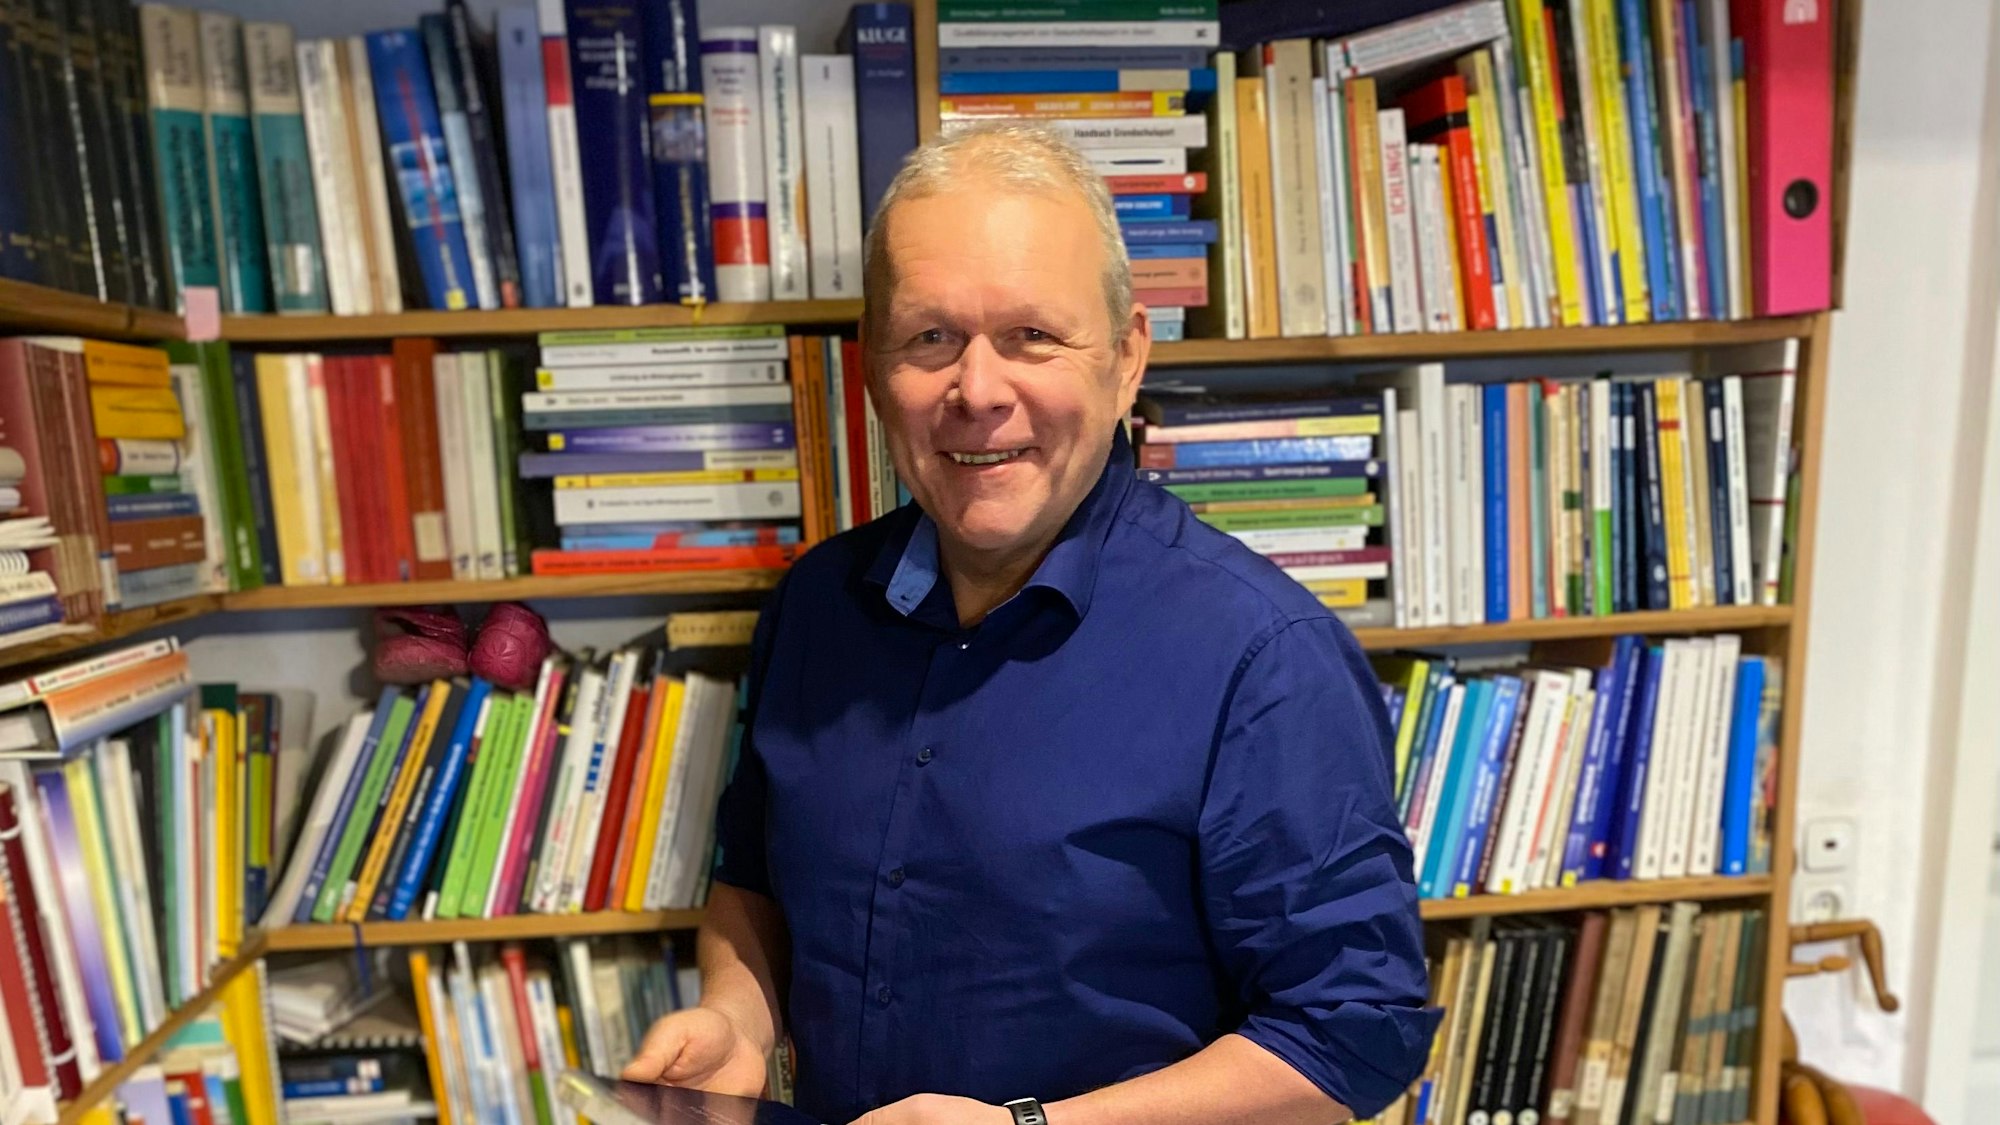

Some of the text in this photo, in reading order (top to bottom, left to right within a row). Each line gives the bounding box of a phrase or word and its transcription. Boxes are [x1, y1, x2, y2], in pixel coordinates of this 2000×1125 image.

[856, 26, 907, 43] KLUGE
[1074, 128, 1112, 139] Handbuch
[1385, 143, 1406, 215] ICHLINGE
